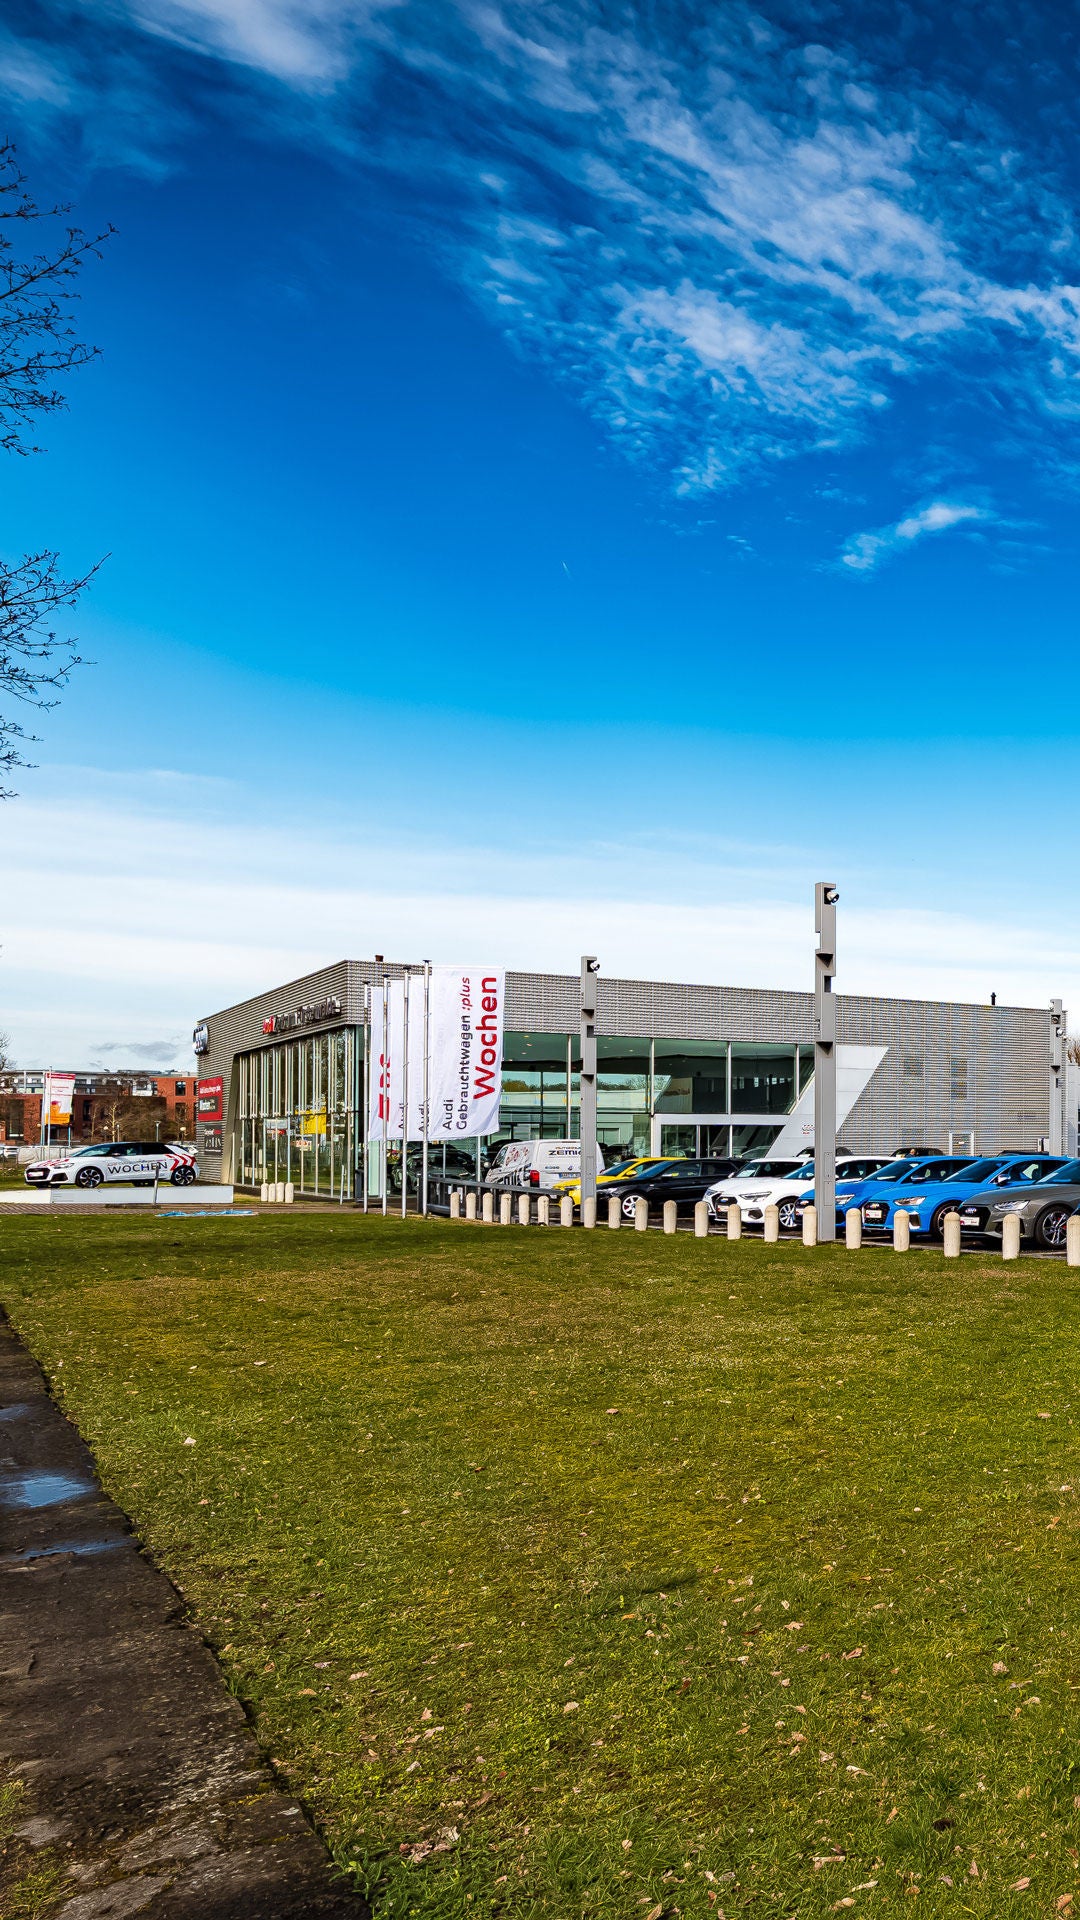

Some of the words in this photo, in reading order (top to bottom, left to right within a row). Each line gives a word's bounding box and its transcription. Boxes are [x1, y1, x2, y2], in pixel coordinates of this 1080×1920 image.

[460, 976, 474, 1011] :plus
[473, 977, 498, 1100] Wochen
[456, 1015, 473, 1130] Gebrauchtwagen
[442, 1098, 454, 1131] Audi
[107, 1160, 168, 1175] WOCHEN
